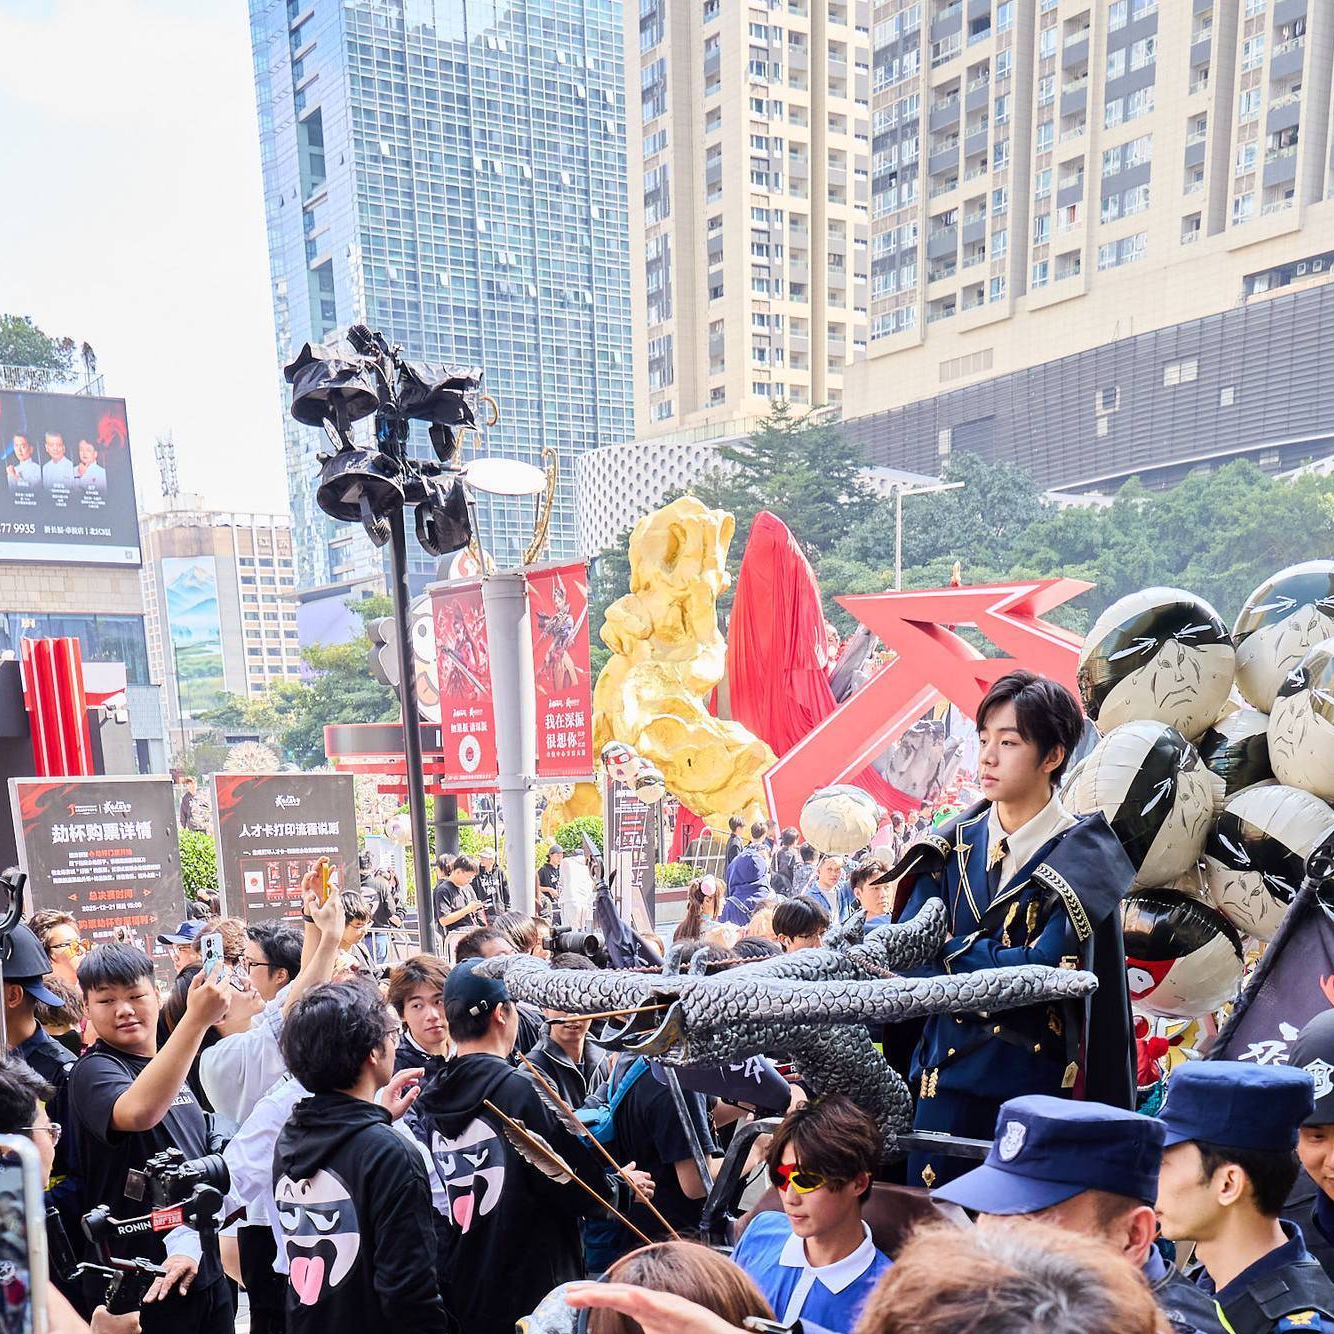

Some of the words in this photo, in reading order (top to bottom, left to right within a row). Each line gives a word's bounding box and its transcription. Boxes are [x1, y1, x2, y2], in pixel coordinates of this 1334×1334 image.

[13, 523, 35, 535] 9935
[545, 711, 585, 730] 我在深振
[546, 731, 578, 749] 很想你
[52, 820, 153, 844] 劫杯购票详情
[118, 1220, 152, 1236] RONIN
